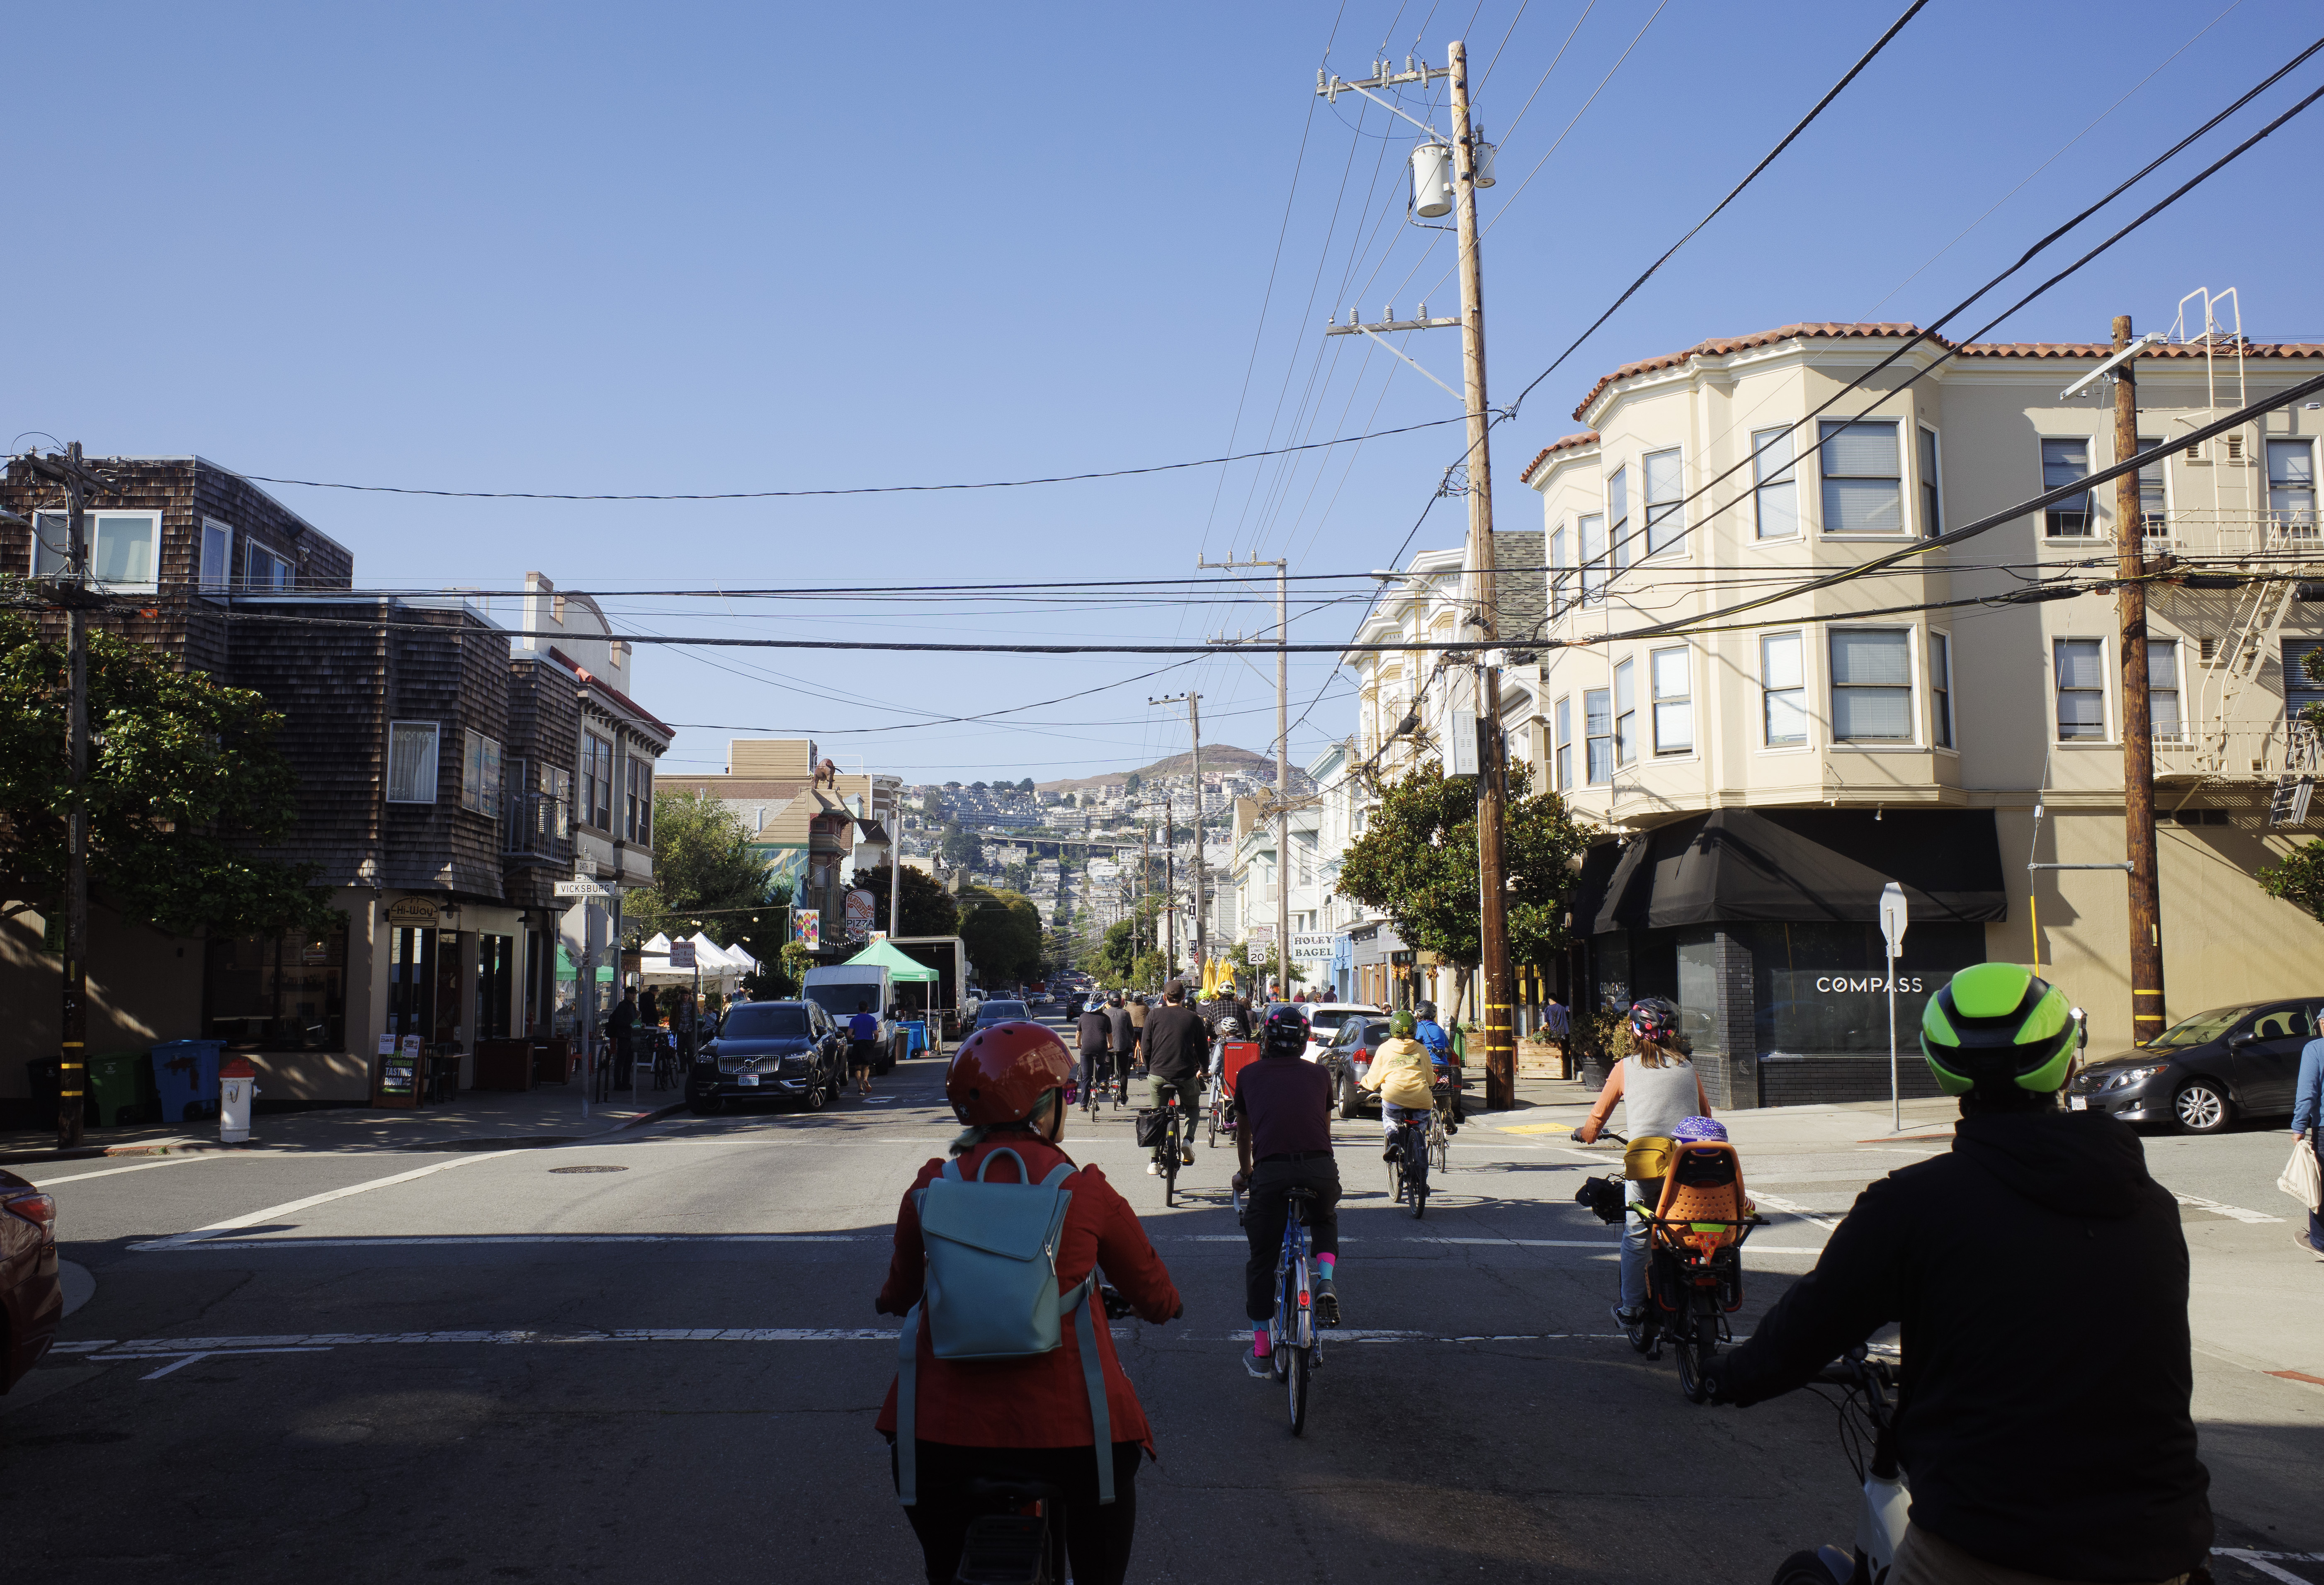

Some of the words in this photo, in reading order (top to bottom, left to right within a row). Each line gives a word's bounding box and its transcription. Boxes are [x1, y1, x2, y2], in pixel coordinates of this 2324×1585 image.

[579, 862, 588, 871] 24TH
[397, 905, 433, 917] Hi-Way
[847, 896, 874, 918] HAYSTACK
[1294, 936, 1333, 944] HOLEY
[1251, 953, 1264, 961] 20
[1600, 982, 1625, 994] COMPASS
[1816, 977, 1923, 992] COMPASS
[385, 1068, 412, 1077] TASTING
[384, 1077, 403, 1086] ROOM
